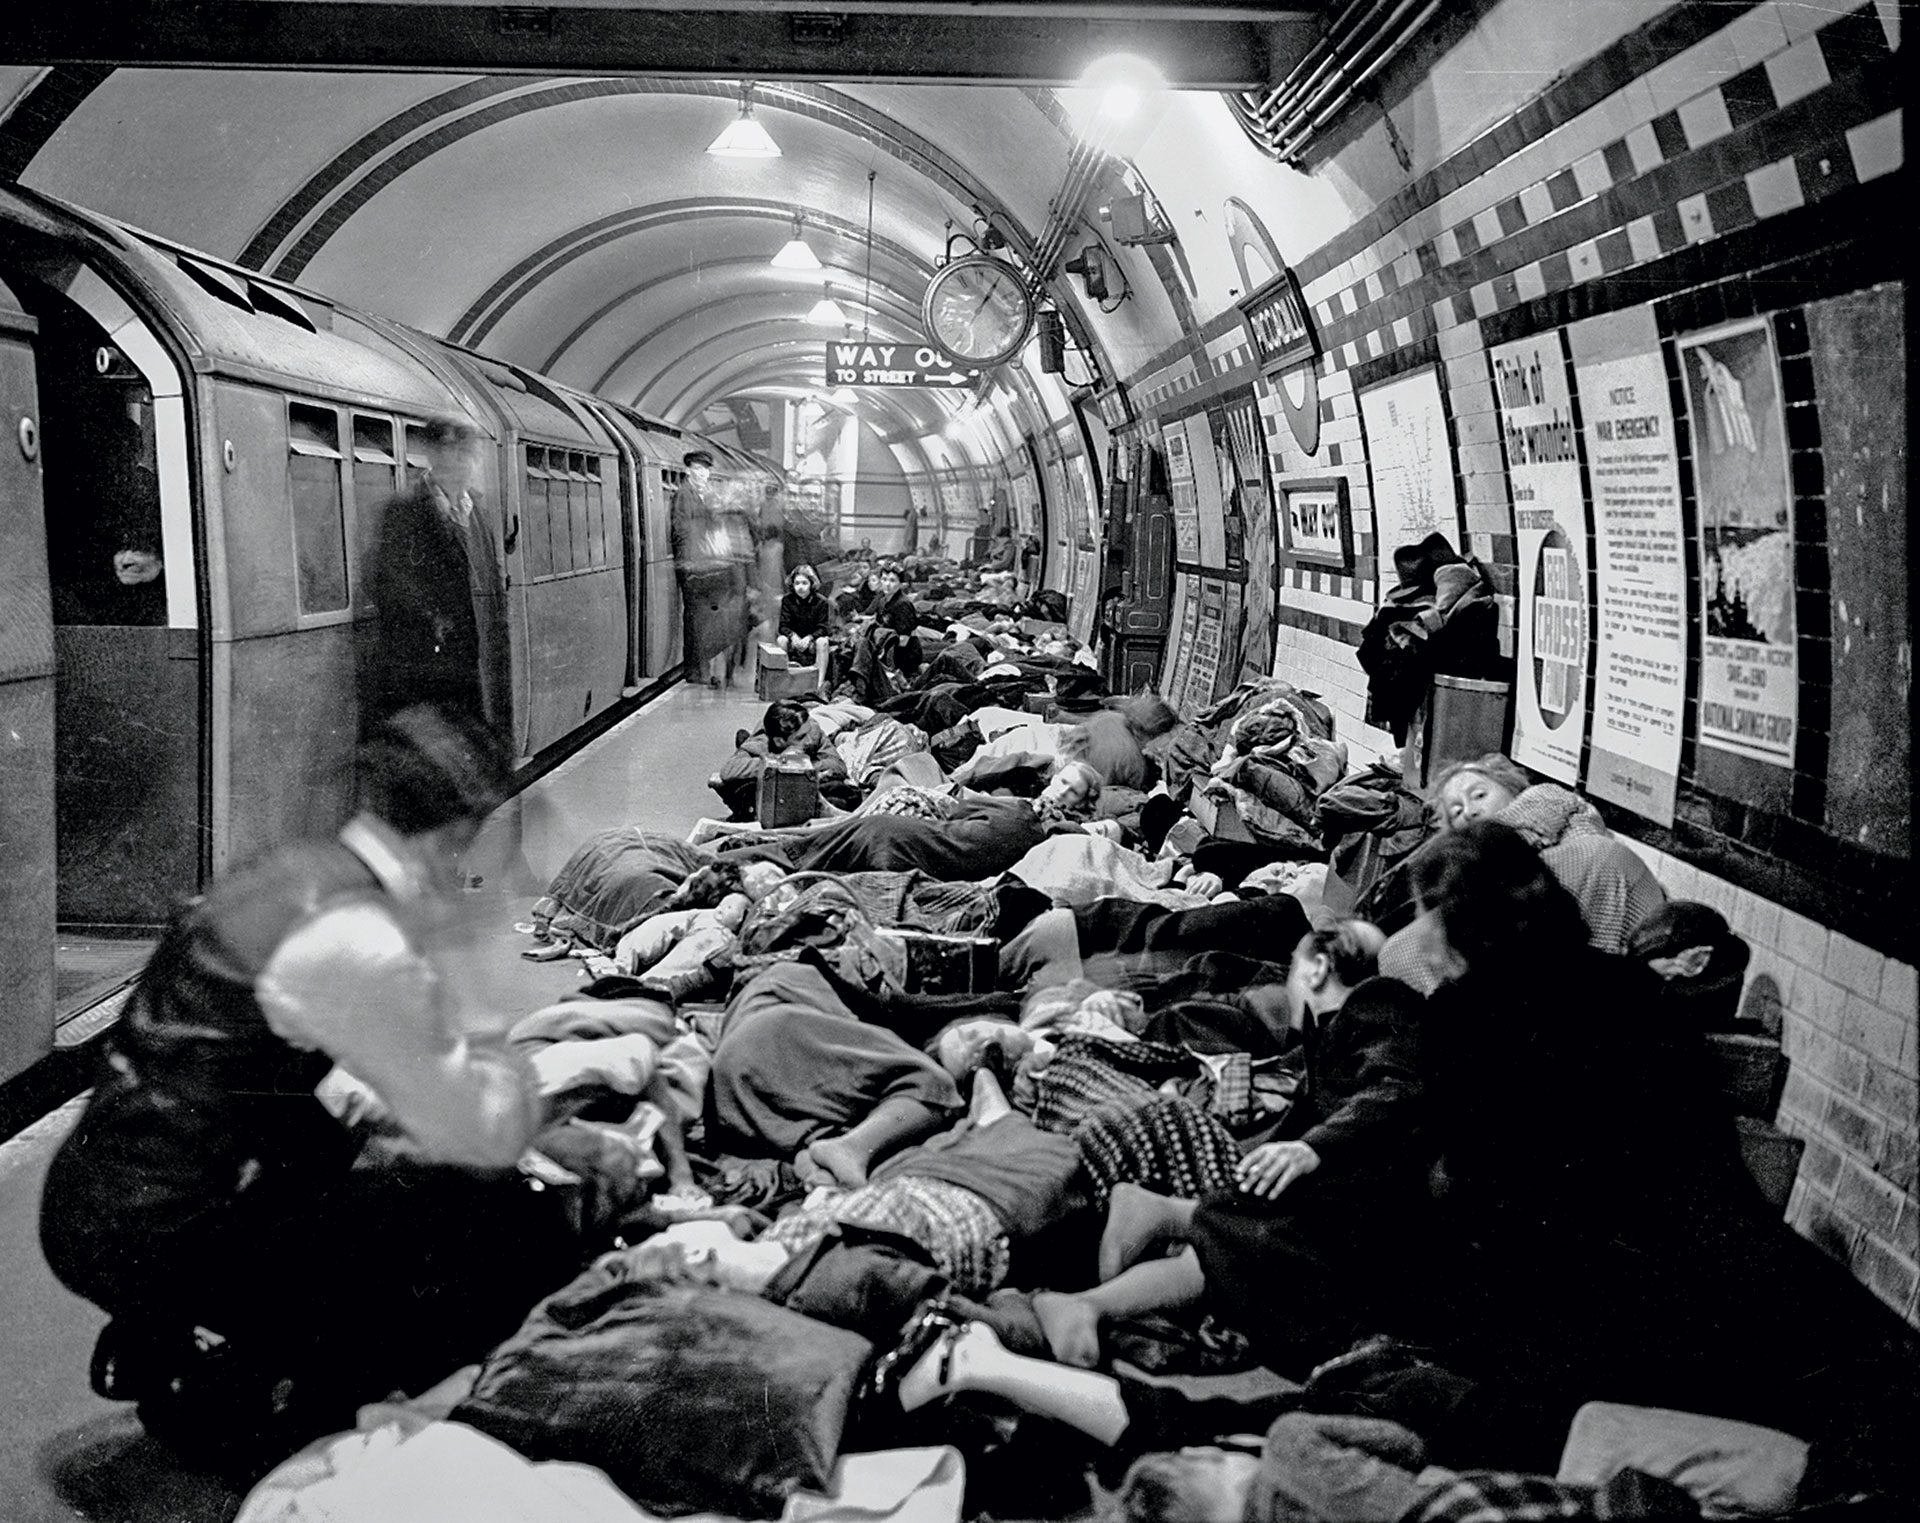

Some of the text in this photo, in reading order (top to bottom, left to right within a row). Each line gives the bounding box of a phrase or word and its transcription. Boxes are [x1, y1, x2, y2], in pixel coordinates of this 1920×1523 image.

[835, 345, 953, 368] WAY OU
[835, 369, 917, 384] TO STREET
[1496, 349, 1546, 409] Think of
[1609, 386, 1636, 406] NOTICE
[1505, 406, 1576, 466] the wounded
[1596, 415, 1660, 441] WAR EMERGENCY
[1546, 554, 1565, 600] RED
[1538, 602, 1578, 660] CROSS
